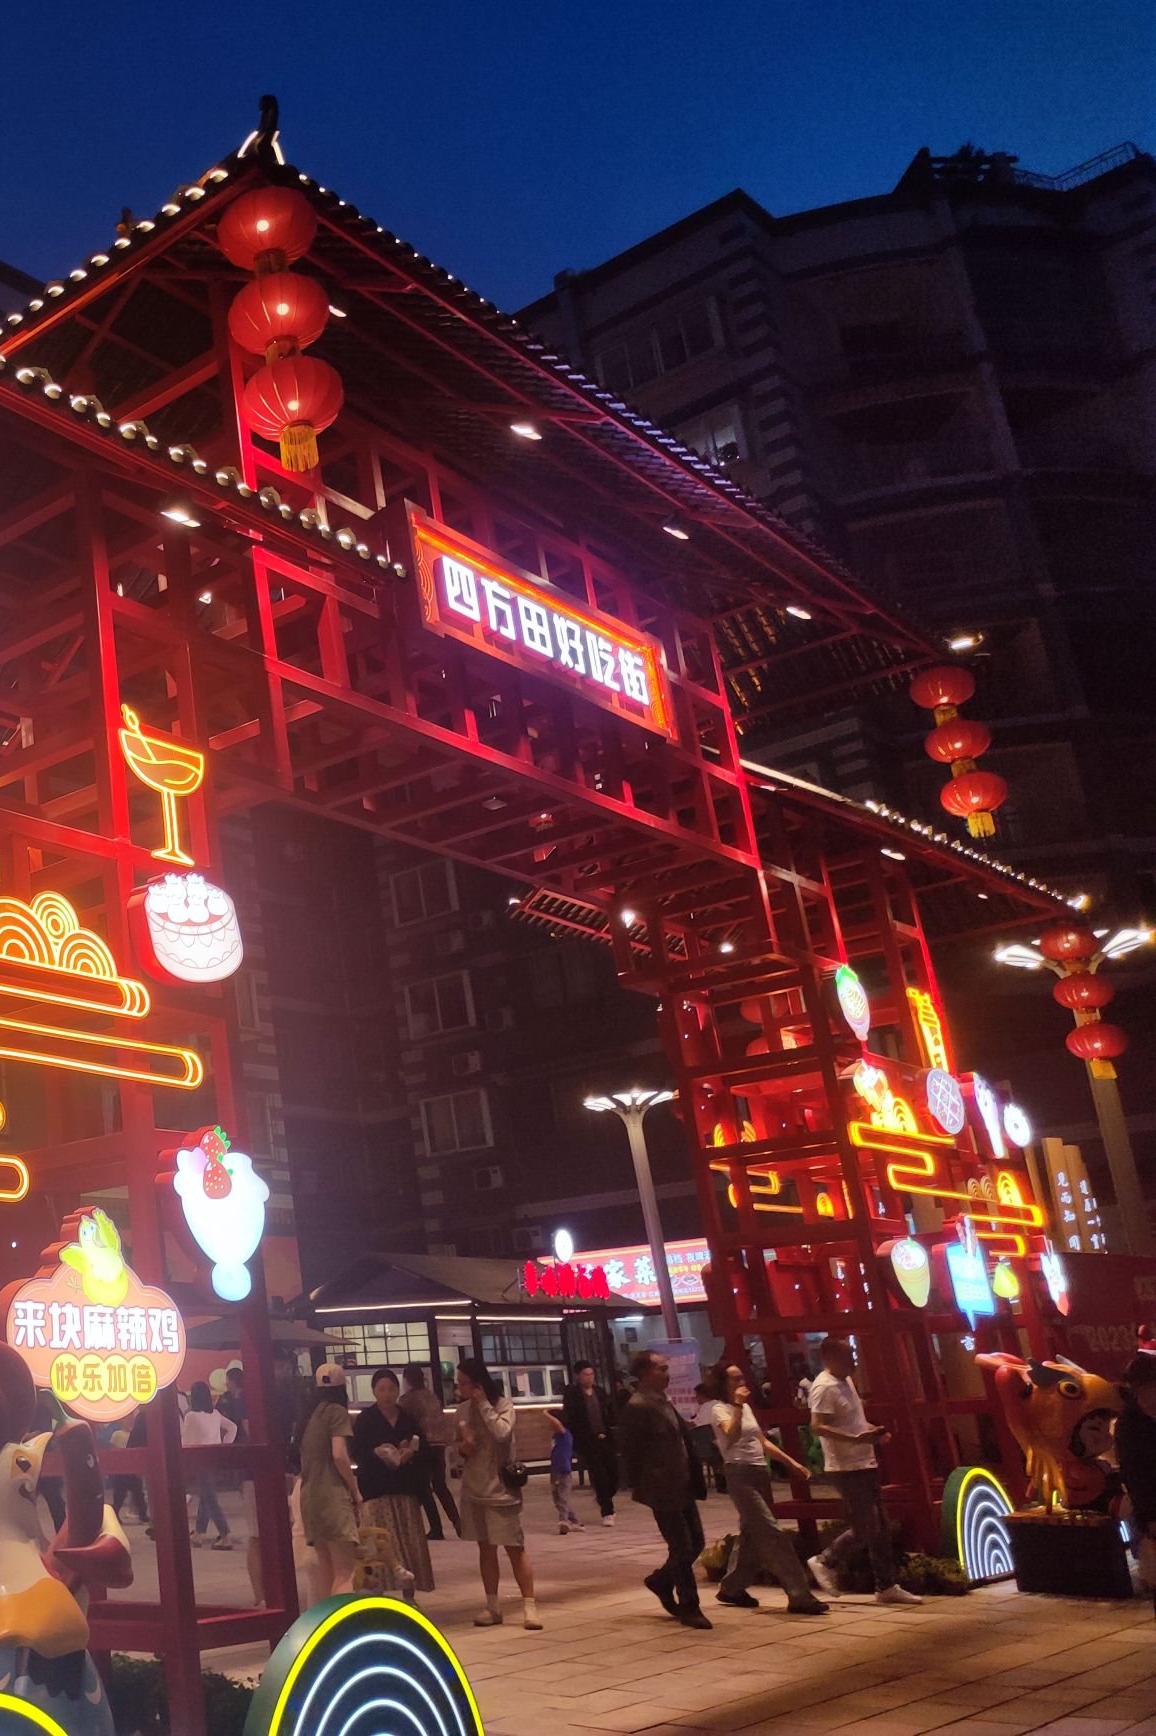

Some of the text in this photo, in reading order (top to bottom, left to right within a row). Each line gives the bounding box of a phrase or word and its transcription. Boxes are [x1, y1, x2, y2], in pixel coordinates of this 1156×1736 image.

[441, 555, 650, 706] 四方田好吃街
[13, 1300, 180, 1353] 来块麻辣鸡
[55, 1362, 153, 1394] 快乐加倍
